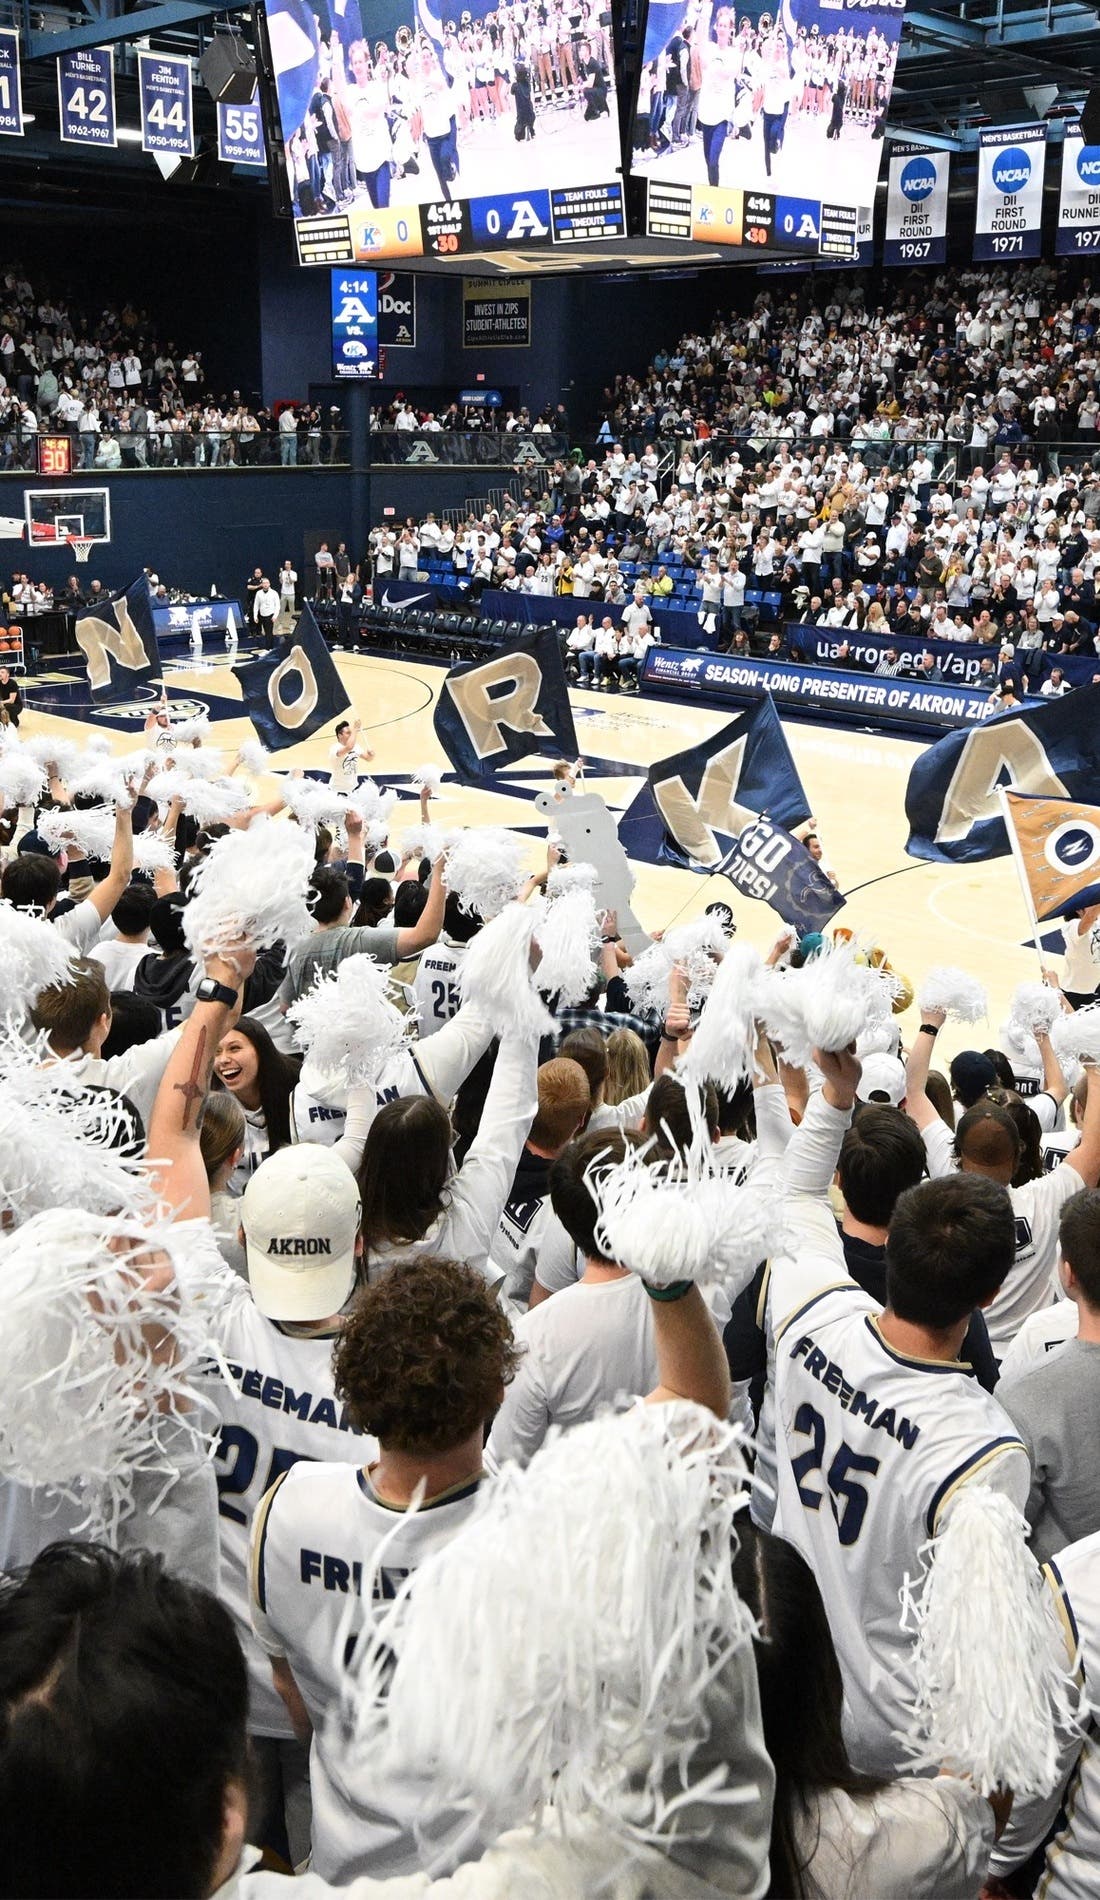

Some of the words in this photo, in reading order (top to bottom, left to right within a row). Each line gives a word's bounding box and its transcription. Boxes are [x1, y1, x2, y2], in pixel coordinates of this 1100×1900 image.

[0, 50, 10, 59] CK
[77, 52, 94, 62] BILL
[70, 60, 101, 72] TURNER
[158, 66, 172, 75] JIM
[152, 74, 179, 86] FENTON
[0, 75, 10, 109] 1
[68, 87, 108, 122] 42
[0, 116, 16, 127] 984
[147, 98, 186, 133] 44
[68, 124, 109, 138] 1962-1967
[226, 109, 258, 142] 55
[1067, 125, 1081, 133] MEN
[147, 135, 189, 149] 1950-1954
[1002, 129, 1044, 141] BASKETBALL
[224, 145, 260, 158] 1959-1961
[892, 145, 910, 153] MEN'S
[996, 168, 1030, 183] NCAA
[1081, 162, 1100, 175] NC
[904, 177, 935, 191] NCAA
[564, 191, 583, 202] TEAM
[585, 189, 608, 199] FOULS
[748, 197, 770, 211] 4:14
[427, 202, 462, 222] 4:14
[506, 200, 549, 239] A
[726, 208, 733, 224] 0
[823, 208, 838, 218] TEAM
[838, 210, 855, 220] FOULS
[996, 207, 1024, 218] FIRST
[1062, 207, 1100, 219] RUNNE
[486, 209, 500, 234] 0
[570, 216, 605, 228] TIMEOUTS
[784, 214, 793, 233] 0
[796, 214, 820, 239] A
[904, 215, 930, 226] FIRST
[991, 219, 1026, 231] ROUND
[397, 220, 408, 242] 0
[750, 227, 767, 244] 30
[856, 224, 871, 234] UR
[900, 226, 932, 237] ROUND
[438, 235, 459, 252] 30
[992, 236, 1023, 252] 1971
[1075, 231, 1100, 247] 197
[900, 243, 931, 258] 1967
[340, 280, 368, 293] 4:14
[334, 296, 376, 323] A
[378, 294, 411, 314] Doc
[474, 303, 496, 316] INVEST
[496, 303, 504, 315] IN
[504, 302, 519, 314] ZIPS
[397, 325, 411, 337] A
[465, 317, 528, 331] STUDENT-ATHLETES!
[405, 440, 440, 462] A
[513, 441, 546, 463] A
[44, 450, 65, 470] 30
[75, 595, 150, 690] N
[654, 656, 680, 671] Wentz
[268, 645, 318, 729] O
[705, 664, 800, 692] SEASON-LONG
[801, 678, 885, 706] PRESENTER
[888, 692, 909, 708] OF
[909, 694, 965, 717] AKRON
[965, 700, 995, 719] ZIP
[445, 652, 556, 760] R
[934, 718, 1072, 843] A
[654, 732, 772, 868] K
[740, 822, 792, 873] GO
[424, 959, 456, 972] FREEM
[1014, 1081, 1033, 1095] ant
[267, 1238, 332, 1255] AKRON
[789, 1336, 920, 1450] FREEMAN
[791, 1403, 880, 1546] 25
